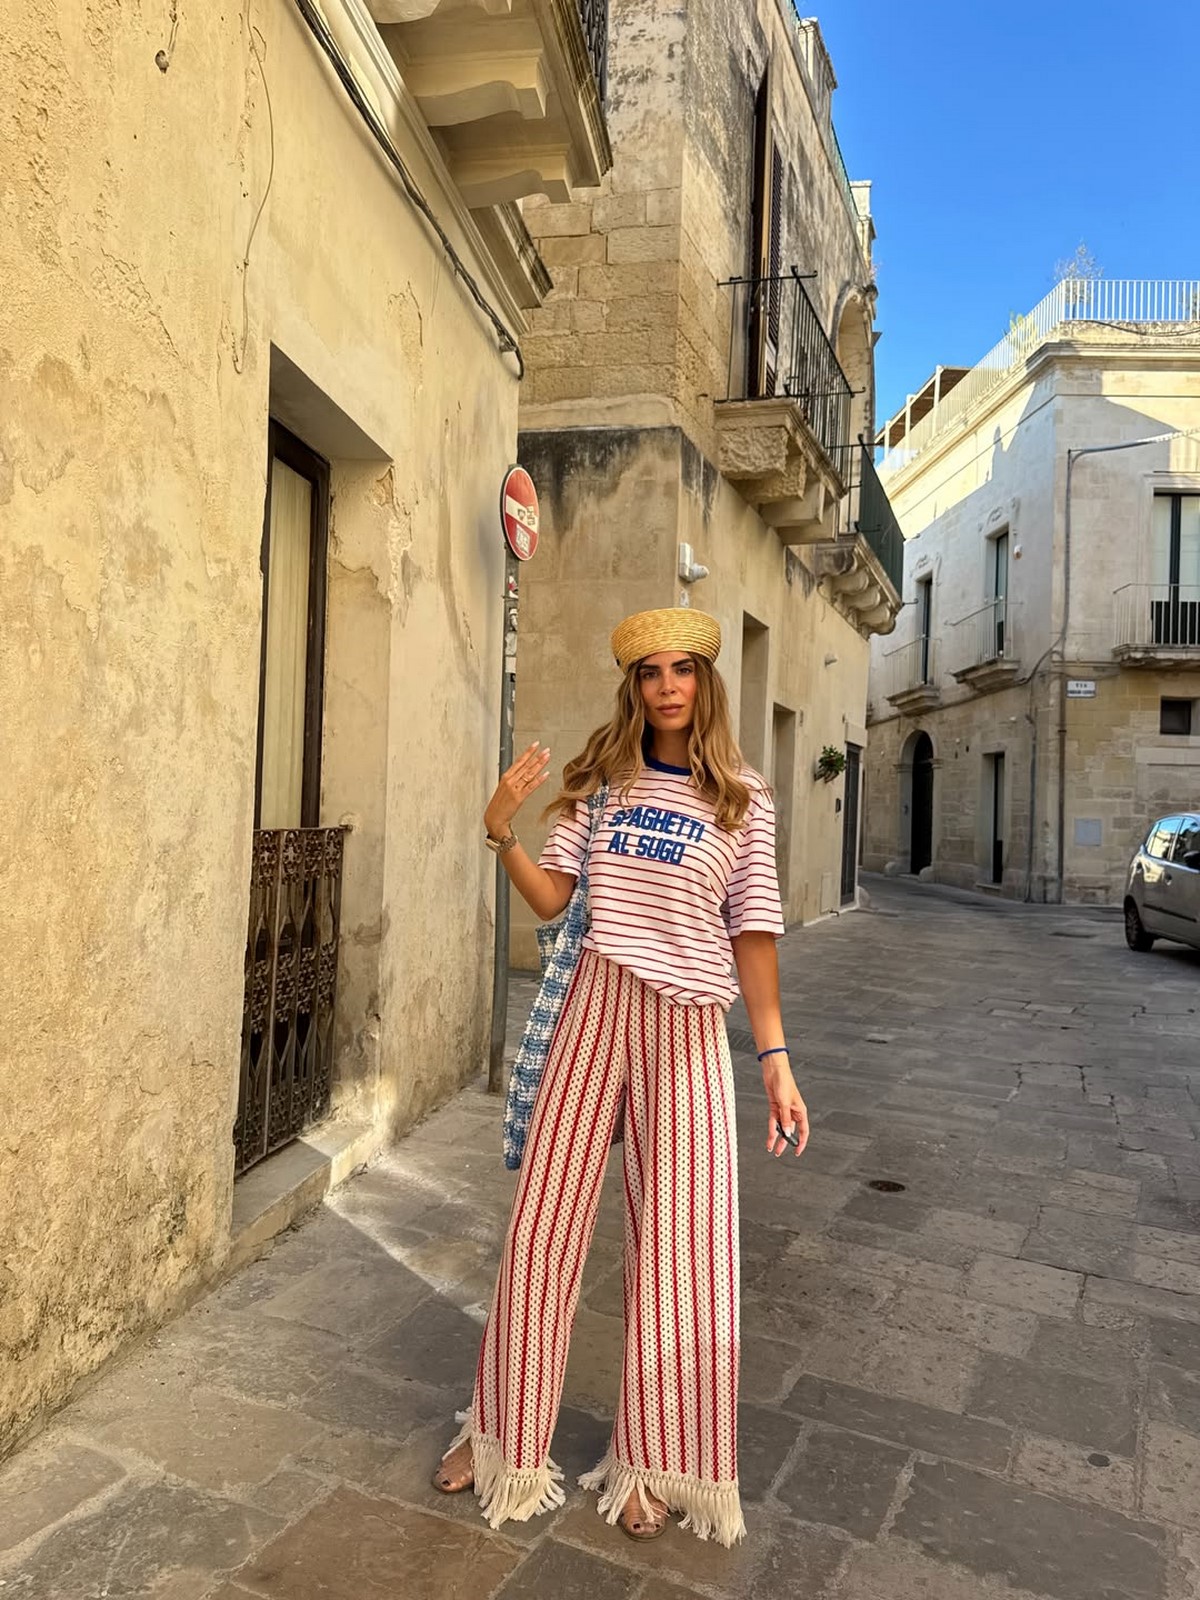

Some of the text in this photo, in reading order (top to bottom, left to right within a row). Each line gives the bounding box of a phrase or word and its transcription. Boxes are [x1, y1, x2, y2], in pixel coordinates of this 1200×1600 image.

[608, 806, 705, 842] SPAGHETTI
[608, 831, 686, 865] AL SUGO
